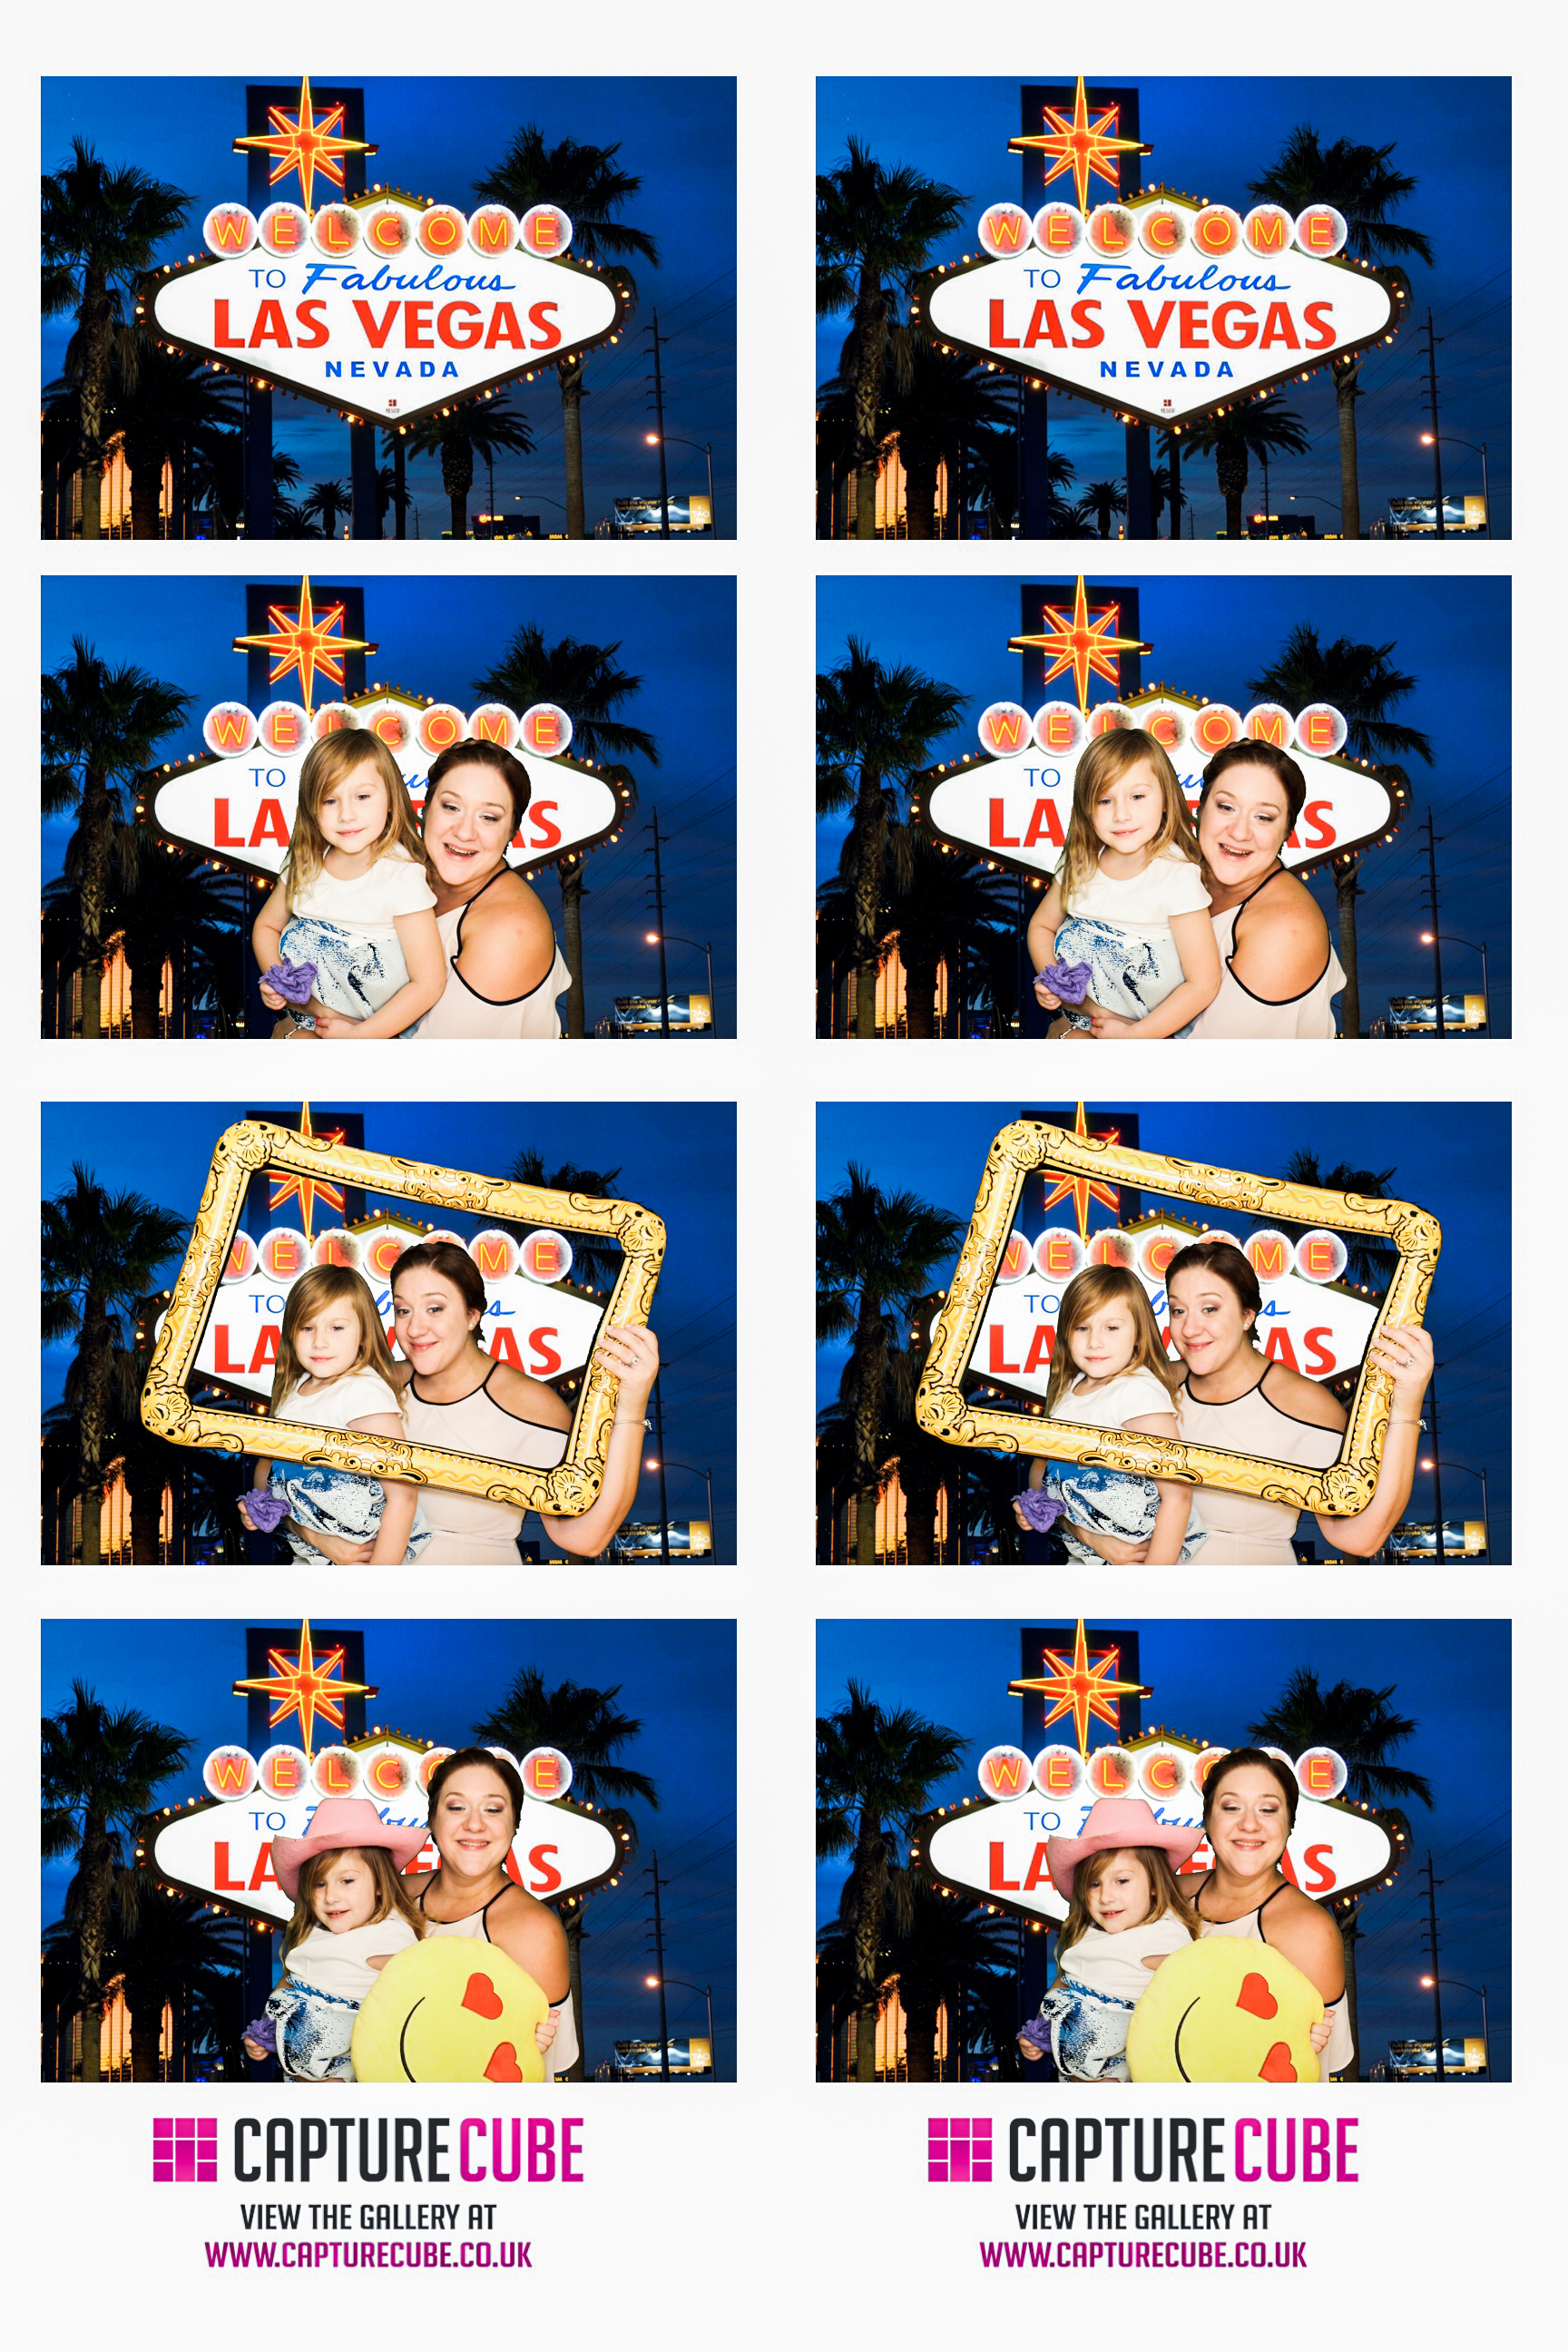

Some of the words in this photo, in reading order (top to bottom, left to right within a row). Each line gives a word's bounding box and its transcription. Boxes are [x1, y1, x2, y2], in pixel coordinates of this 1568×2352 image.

[213, 216, 555, 247] WELCOME
[988, 216, 1330, 247] WELCOME
[249, 269, 286, 289] TO
[301, 262, 516, 295] Fabulous
[1024, 269, 1061, 289] TO
[1076, 262, 1291, 295] Fabulous
[213, 299, 330, 349] LAS
[352, 299, 562, 350] VEGAS
[988, 299, 1105, 349] LAS
[1127, 299, 1337, 350] VEGAS
[325, 360, 459, 378] NEVADA
[1100, 360, 1234, 378] NEVADA
[691, 510, 710, 518] TAO
[1465, 510, 1485, 518] TAO
[249, 768, 286, 788] TO
[1024, 768, 1061, 788] TO
[213, 798, 290, 848] LA
[988, 798, 1065, 848] LA
[691, 1009, 710, 1017] TAO
[1465, 1009, 1485, 1017] TAO
[249, 1294, 284, 1314] TO
[1024, 1294, 1059, 1314] TO
[213, 1324, 282, 1375] LA
[988, 1324, 1057, 1375] LA
[691, 1535, 710, 1544] TAO
[1465, 1535, 1485, 1544] TAO
[213, 1759, 555, 1789] WELCE
[988, 1759, 1330, 1789] WELCE
[249, 1811, 286, 1831] TO
[1024, 1811, 1061, 1831] TO
[213, 1841, 280, 1892] LA
[988, 1841, 1055, 1892] LA
[691, 2053, 710, 2061] TAO
[1465, 2053, 1485, 2061] TAO
